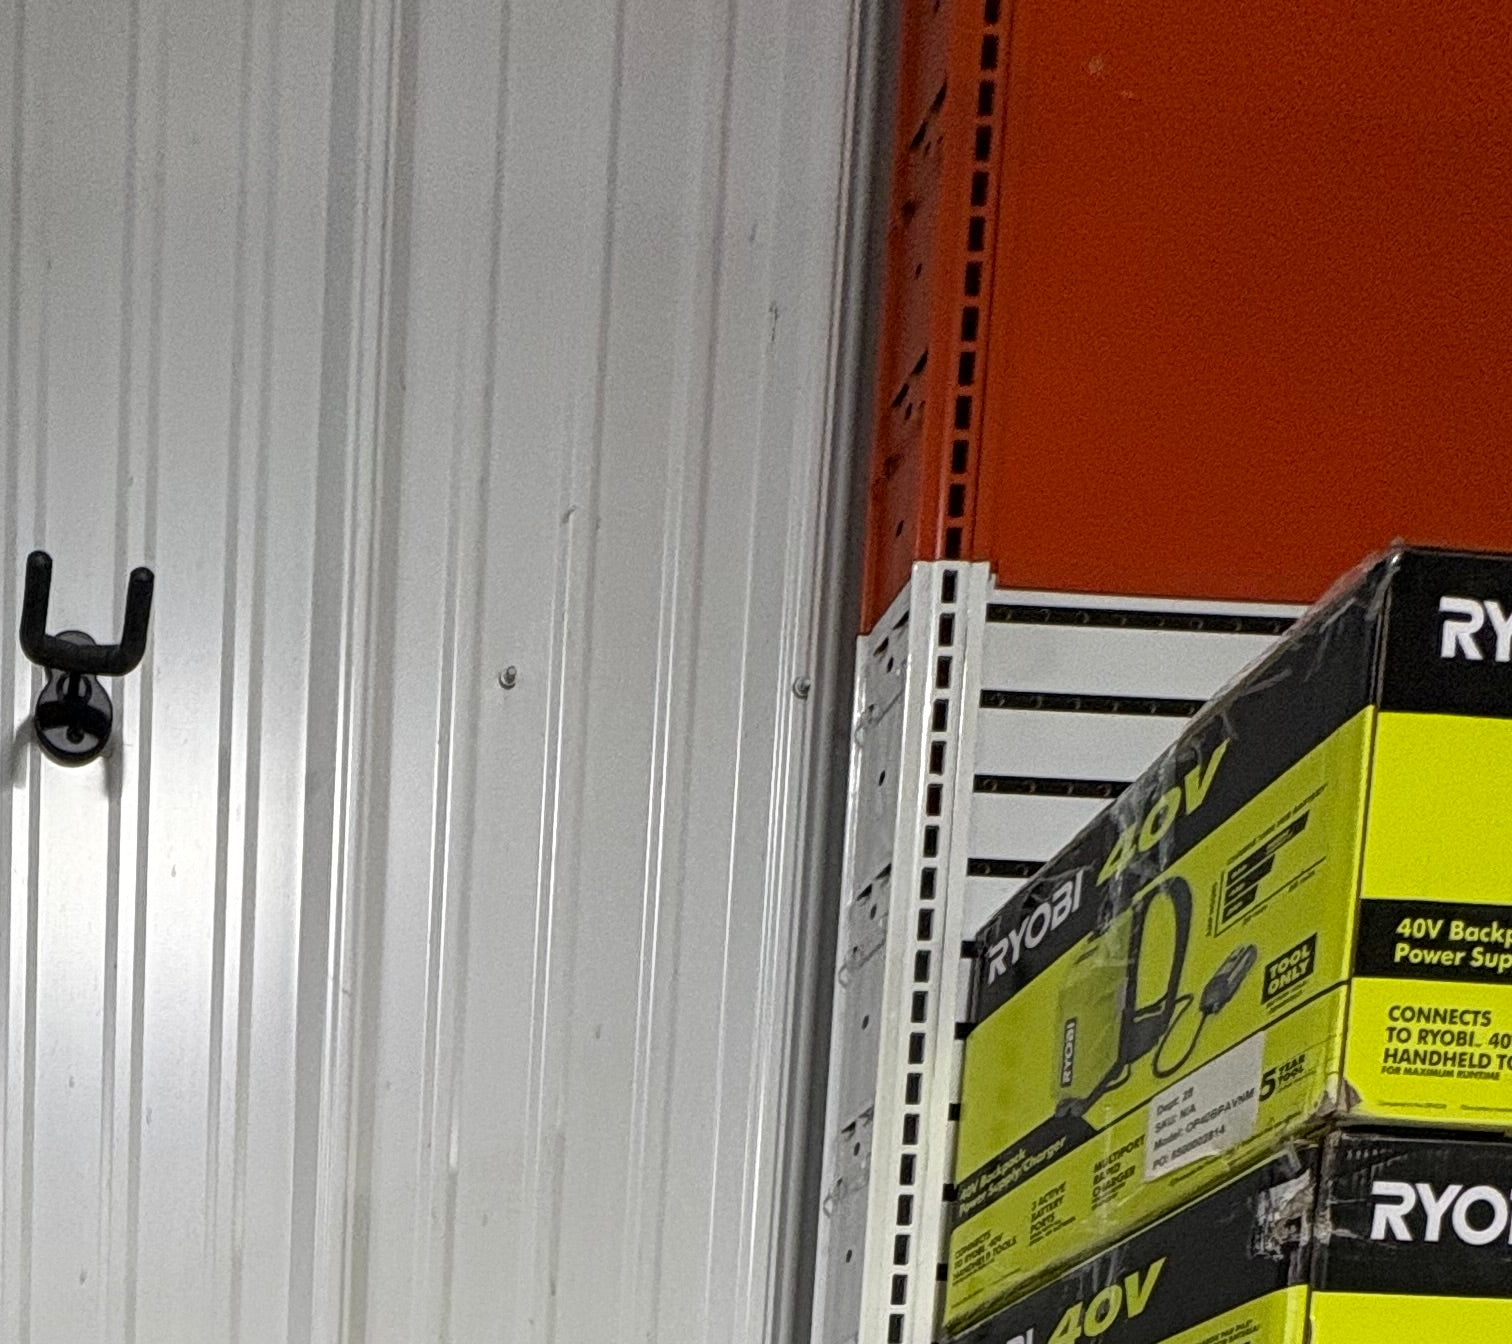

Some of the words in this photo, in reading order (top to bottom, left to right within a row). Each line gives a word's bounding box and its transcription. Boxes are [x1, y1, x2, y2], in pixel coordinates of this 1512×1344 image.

[988, 869, 1085, 984] RYOBI
[1096, 738, 1231, 887] 40V
[1396, 917, 1444, 940] 40V
[1269, 943, 1310, 978] TOOL
[1394, 942, 1466, 966] Power
[1267, 960, 1309, 996] ONLY
[1388, 1005, 1492, 1028] CONNECTS
[1385, 1026, 1412, 1043] TO
[1062, 1022, 1075, 1084] RYOBI
[1383, 1047, 1492, 1070] HANDHELD
[1259, 1066, 1279, 1102] 5
[1381, 1066, 1401, 1076] FOR
[1370, 1181, 1512, 1246] RYO
